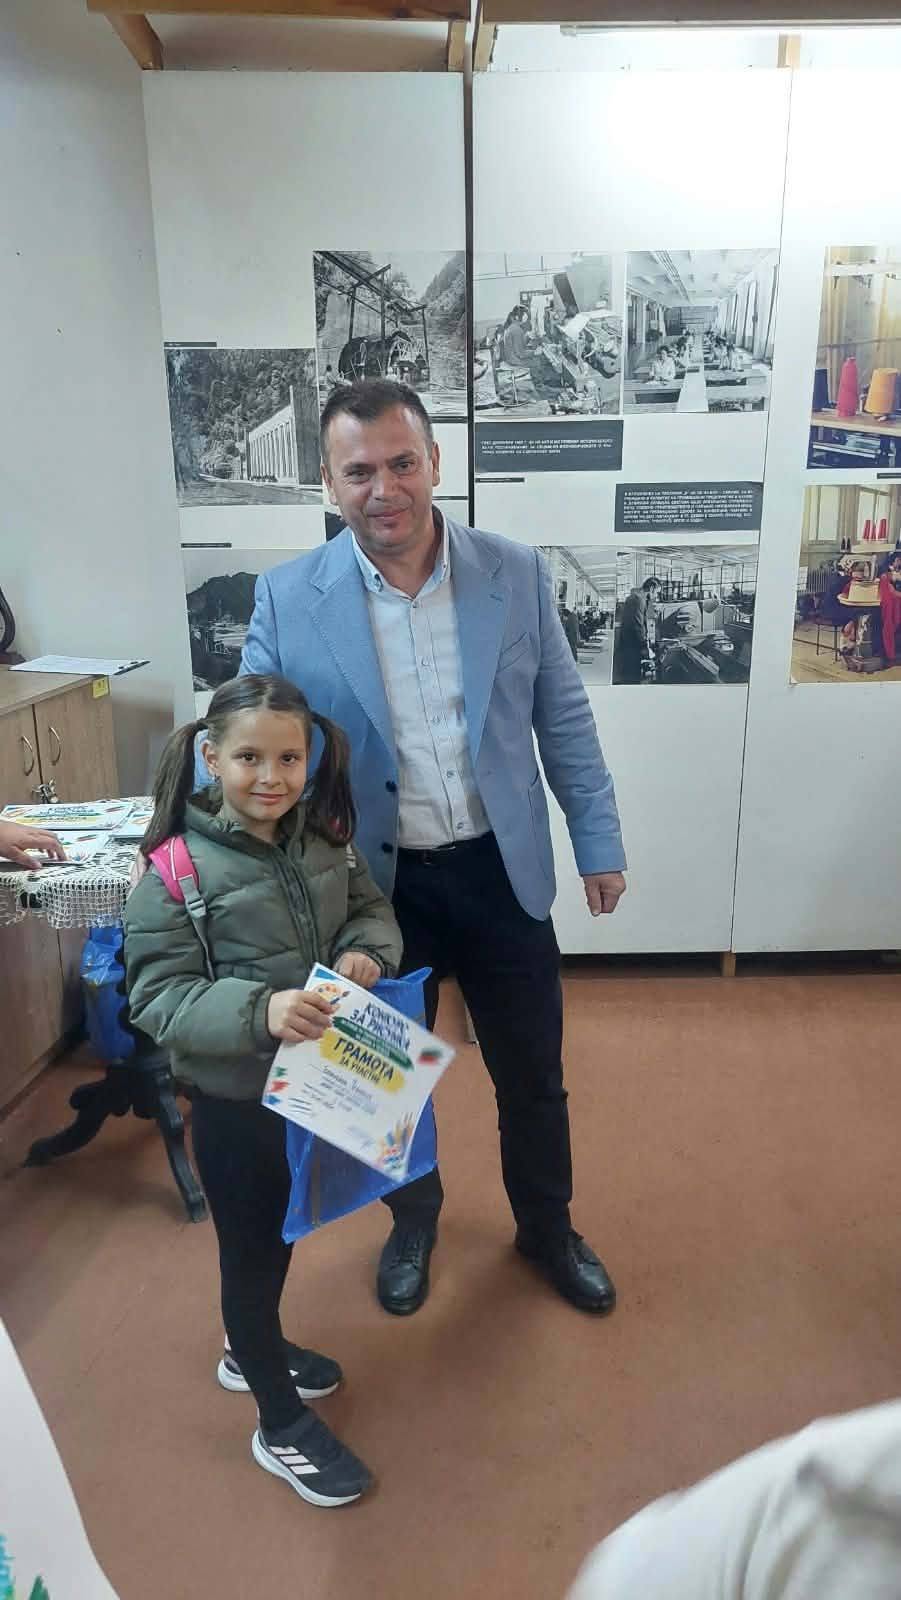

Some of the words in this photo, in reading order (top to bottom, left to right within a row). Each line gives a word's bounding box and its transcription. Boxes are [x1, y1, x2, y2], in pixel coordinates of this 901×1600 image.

[350, 1009, 366, 1025] ЗА
[333, 1038, 394, 1080] ГРАМОТА
[339, 1057, 352, 1070] ЗА
